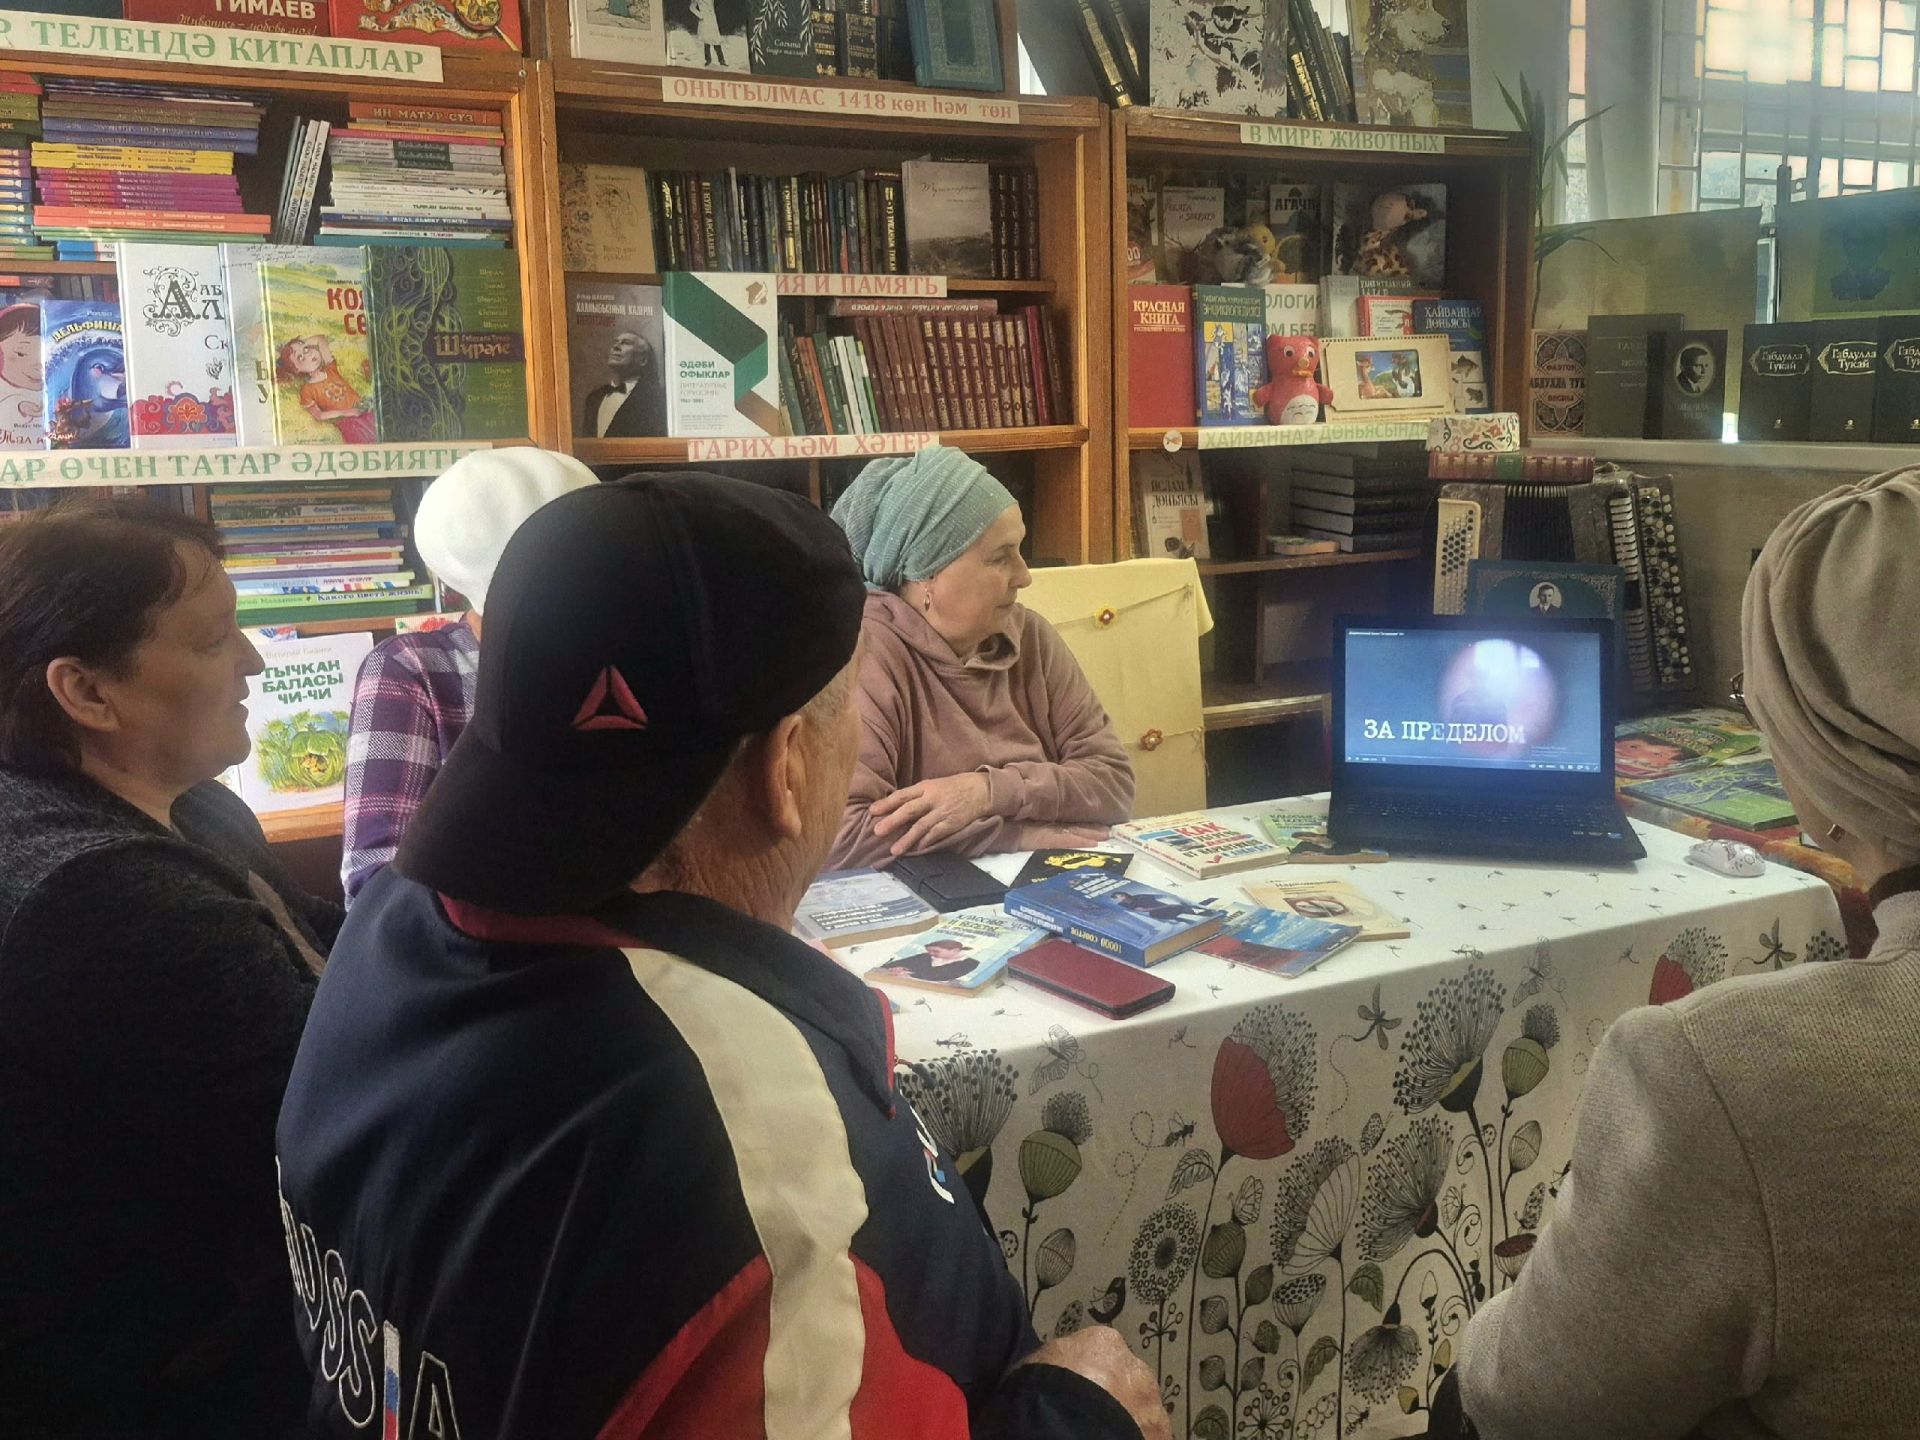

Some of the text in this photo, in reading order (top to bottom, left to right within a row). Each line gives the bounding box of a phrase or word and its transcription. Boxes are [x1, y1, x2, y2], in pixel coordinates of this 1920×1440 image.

[31, 20, 216, 61] ТЕЛЕНДӘ
[229, 36, 425, 74] КИТАПЛАР
[673, 79, 1012, 119] ОНЫТЫЛМАС 1418 көн һәм төн
[398, 110, 443, 120] МАТУР
[1249, 125, 1440, 152] В МИРЕ ЖИВОТНЫХ
[815, 275, 831, 293] И
[841, 276, 939, 295] ПАМЯТЬ
[1132, 299, 1185, 313] КРАСНАЯ
[1424, 304, 1482, 318] ХАЙВАННАР
[1140, 312, 1180, 325] КНИГА
[1425, 317, 1471, 330] ДӨНЬЯСЫ
[1761, 350, 1803, 363] Габдулла
[1832, 348, 1877, 361] Габдулла
[1767, 361, 1797, 371] Тукай
[1837, 358, 1870, 371] Тукай
[1206, 421, 1432, 448] ХАЙВАННАР ДӨНЬЯСЫНДА
[689, 434, 931, 462] ТАРИХ ҺӘМ ХӘТЕР
[59, 458, 158, 482] ӨЧЕН
[168, 453, 282, 479] ТАТАР
[317, 591, 355, 602] Какого
[356, 590, 385, 600] цвета
[264, 659, 341, 679] ТЫЧКАН
[262, 672, 344, 693] БАЛАСЫ
[277, 687, 332, 705] ЧИ-ЧИ
[1363, 719, 1527, 744] ЗА ПРЕДЕЛОМ
[1174, 822, 1229, 837] КАК
